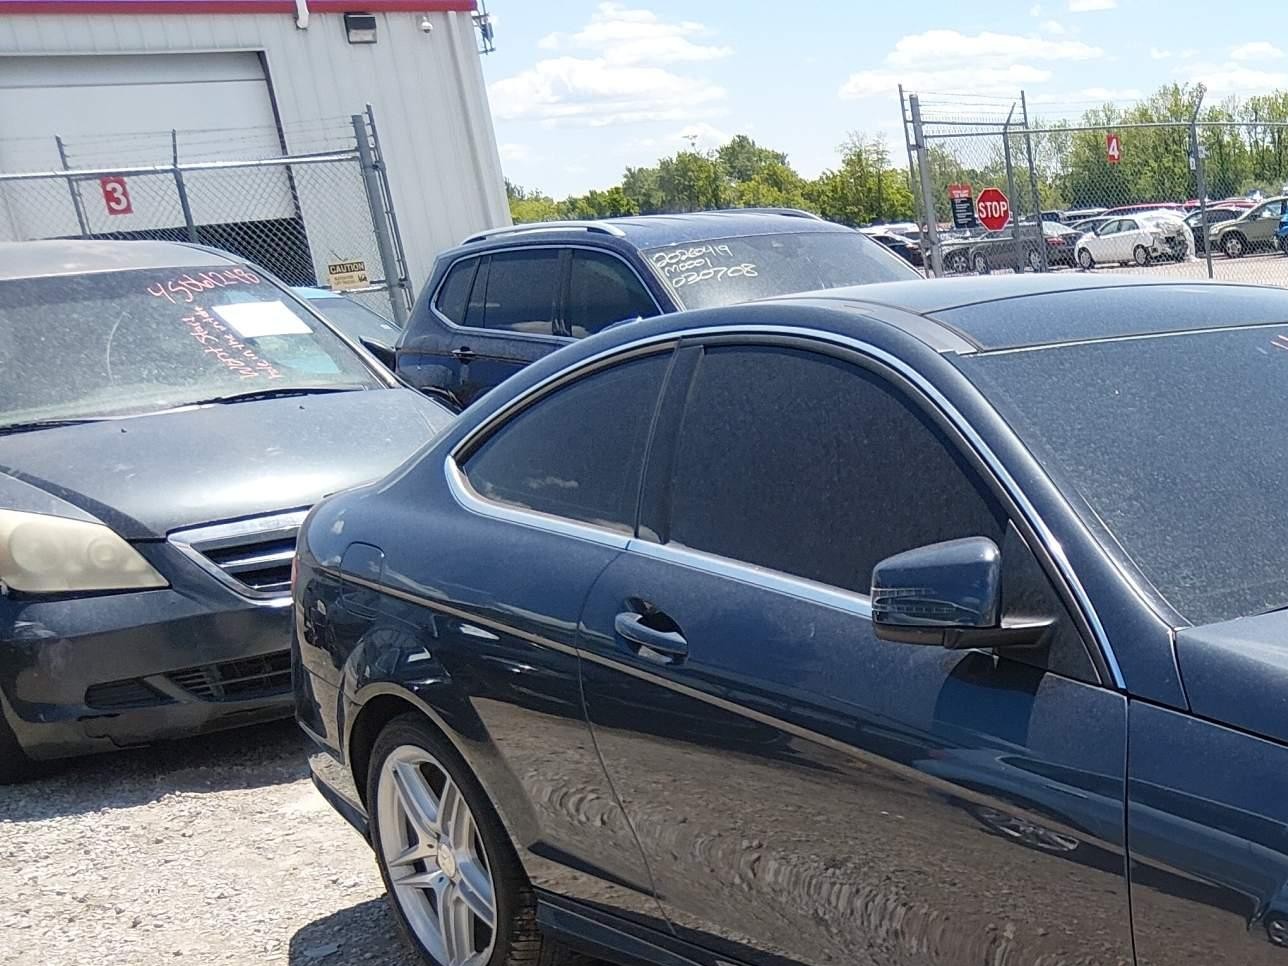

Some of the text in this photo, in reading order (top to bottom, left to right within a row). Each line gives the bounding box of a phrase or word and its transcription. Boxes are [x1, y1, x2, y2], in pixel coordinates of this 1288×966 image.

[1108, 138, 1119, 160] 4
[106, 182, 128, 210] 3
[978, 201, 1007, 218] STOP
[330, 262, 365, 274] CAUTION
